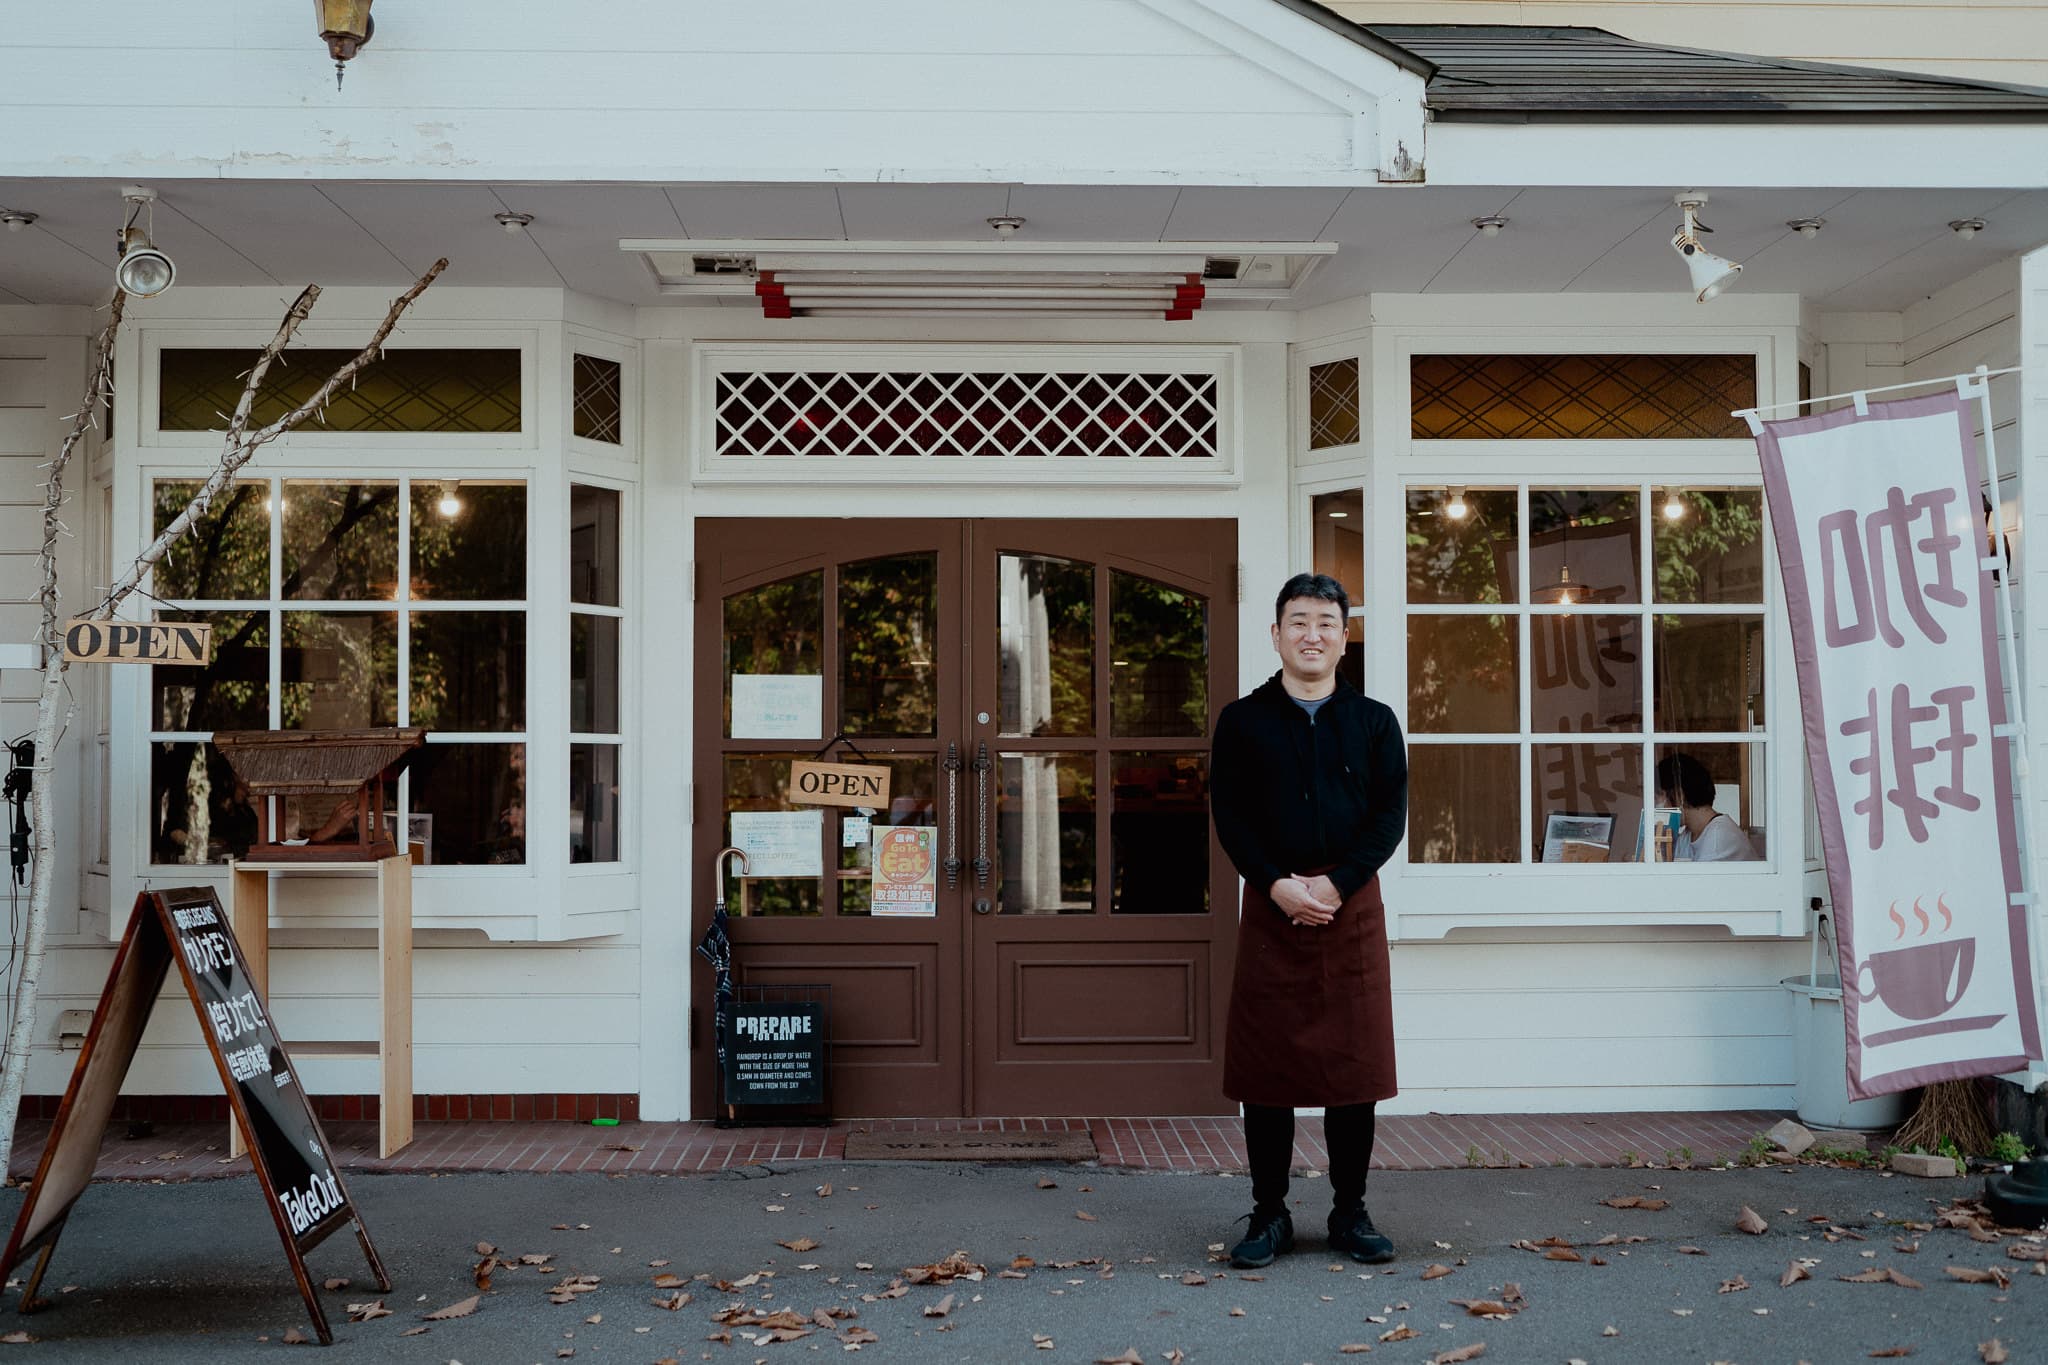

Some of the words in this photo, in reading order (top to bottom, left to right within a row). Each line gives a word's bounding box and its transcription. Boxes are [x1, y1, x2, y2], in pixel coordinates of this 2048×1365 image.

[66, 624, 210, 660] OPEN
[799, 772, 883, 797] OPEN
[883, 851, 926, 873] Eat
[180, 932, 236, 975] カリオモン
[736, 1016, 812, 1034] PREPARE
[753, 1032, 770, 1041] FOR
[773, 1032, 795, 1041] RAIN
[225, 1042, 272, 1083] 焙煎体験
[760, 1072, 783, 1080] DIAMETER
[794, 1071, 812, 1079] COMES
[749, 1082, 764, 1090] DOWN
[883, 1141, 1058, 1150] WELCOME
